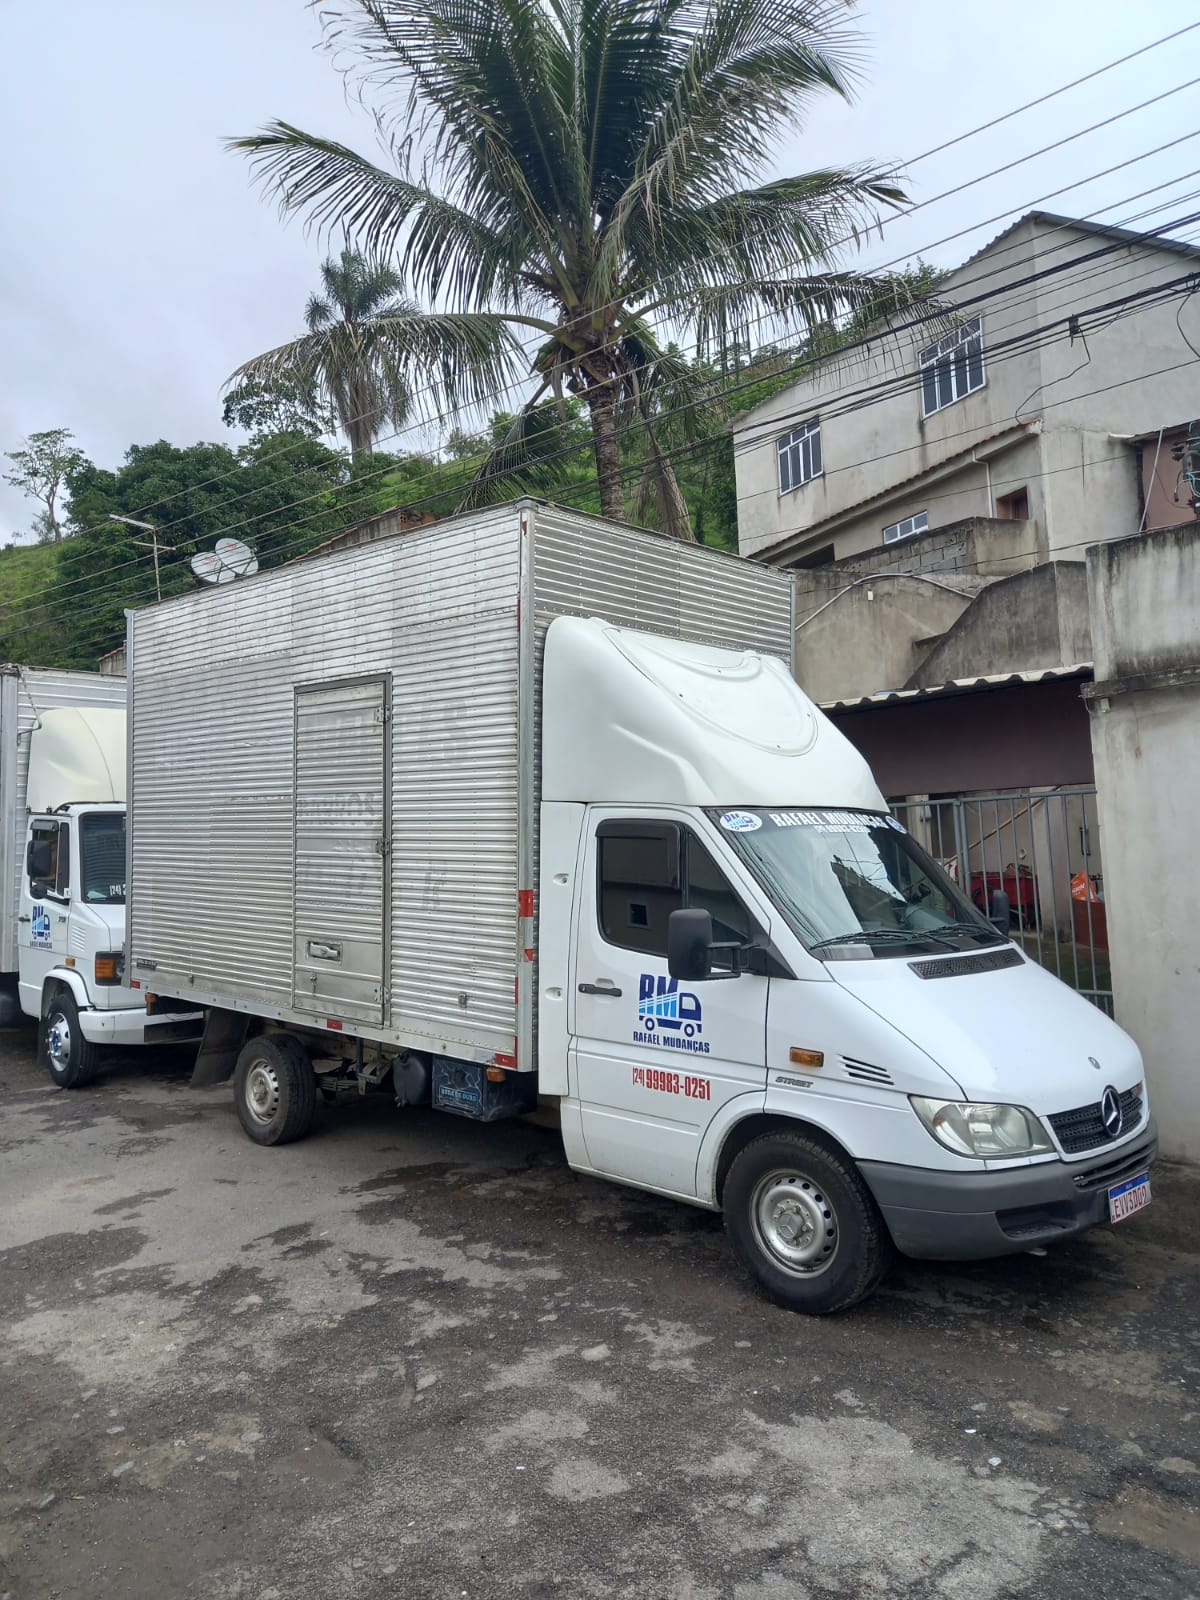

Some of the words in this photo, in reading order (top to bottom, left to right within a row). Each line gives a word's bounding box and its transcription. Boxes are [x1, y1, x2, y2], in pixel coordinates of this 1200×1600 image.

[768, 812, 827, 827] RAFAEL
[633, 1031, 661, 1046] RAFAEL
[662, 1035, 710, 1053] MUDANÇAS
[632, 1067, 645, 1087] (24)
[646, 1068, 711, 1101] 99983-0251
[775, 1076, 814, 1088] STREET
